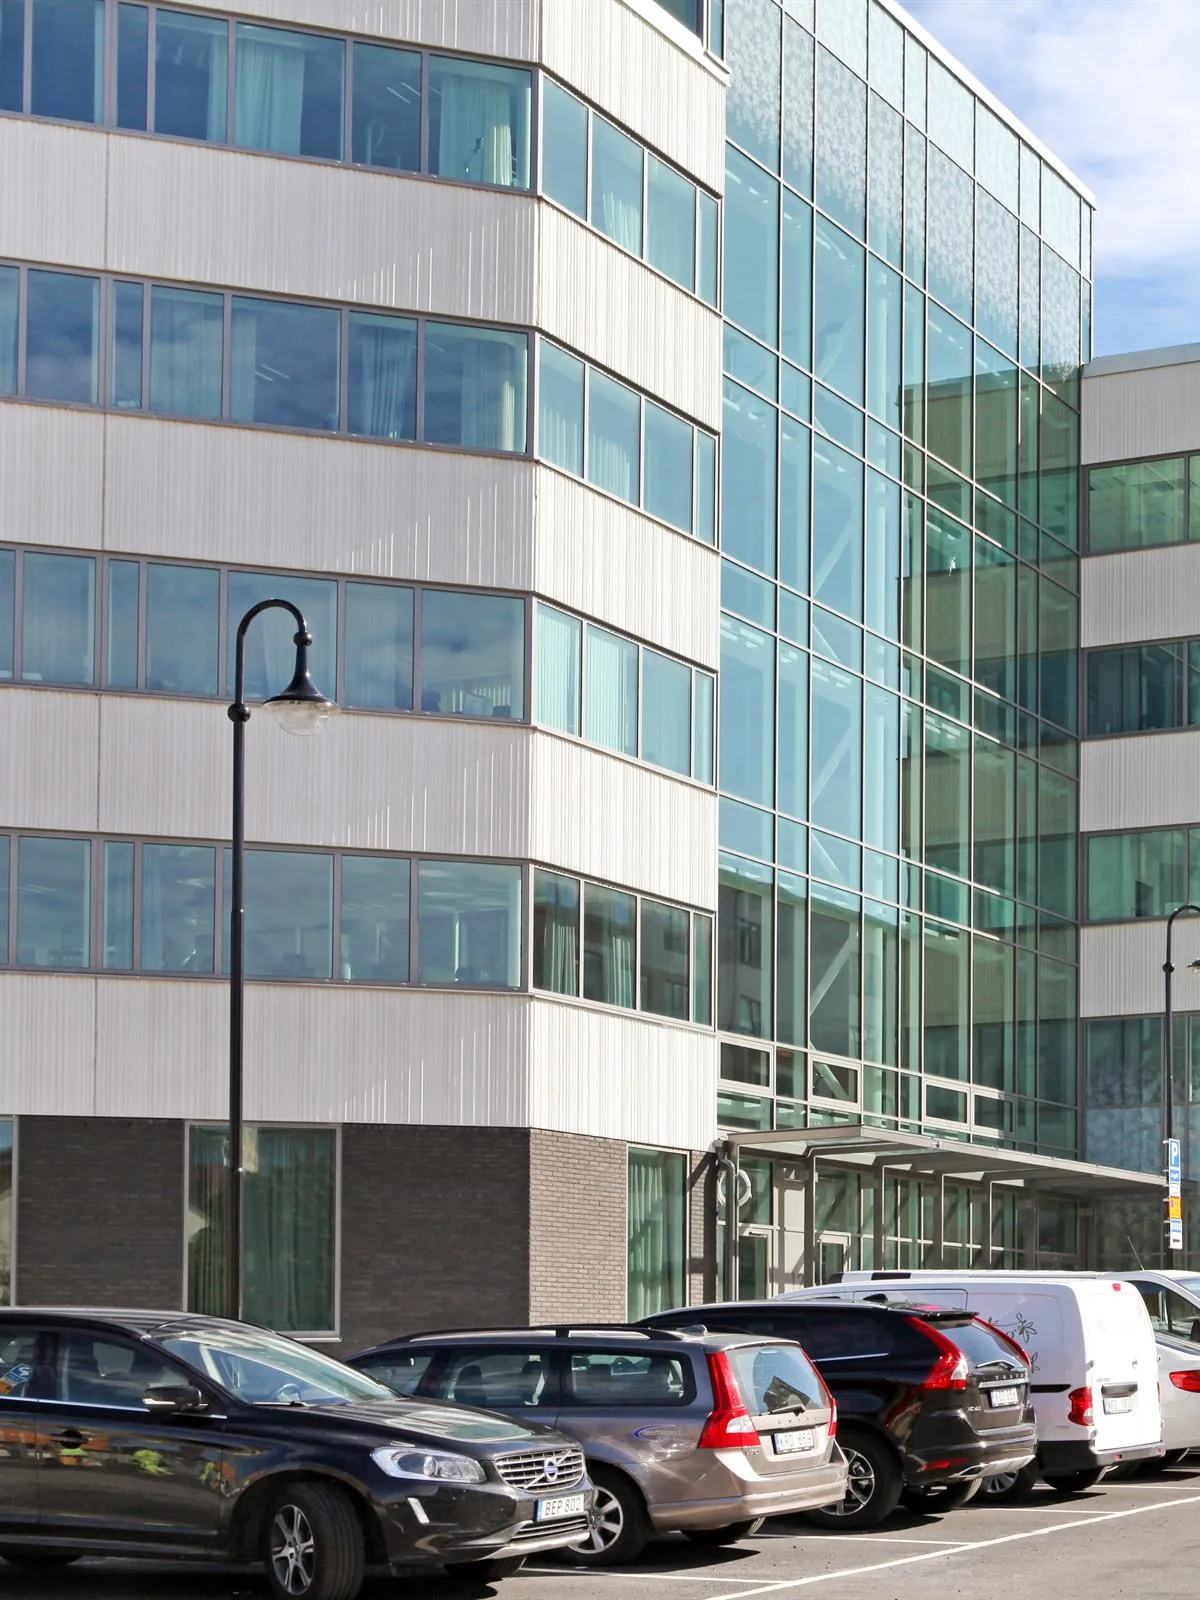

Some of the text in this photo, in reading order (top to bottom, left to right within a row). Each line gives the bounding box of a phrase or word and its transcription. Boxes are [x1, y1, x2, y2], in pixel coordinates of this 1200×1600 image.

[1171, 1141, 1179, 1166] P
[545, 1496, 581, 1516] BEP 802
